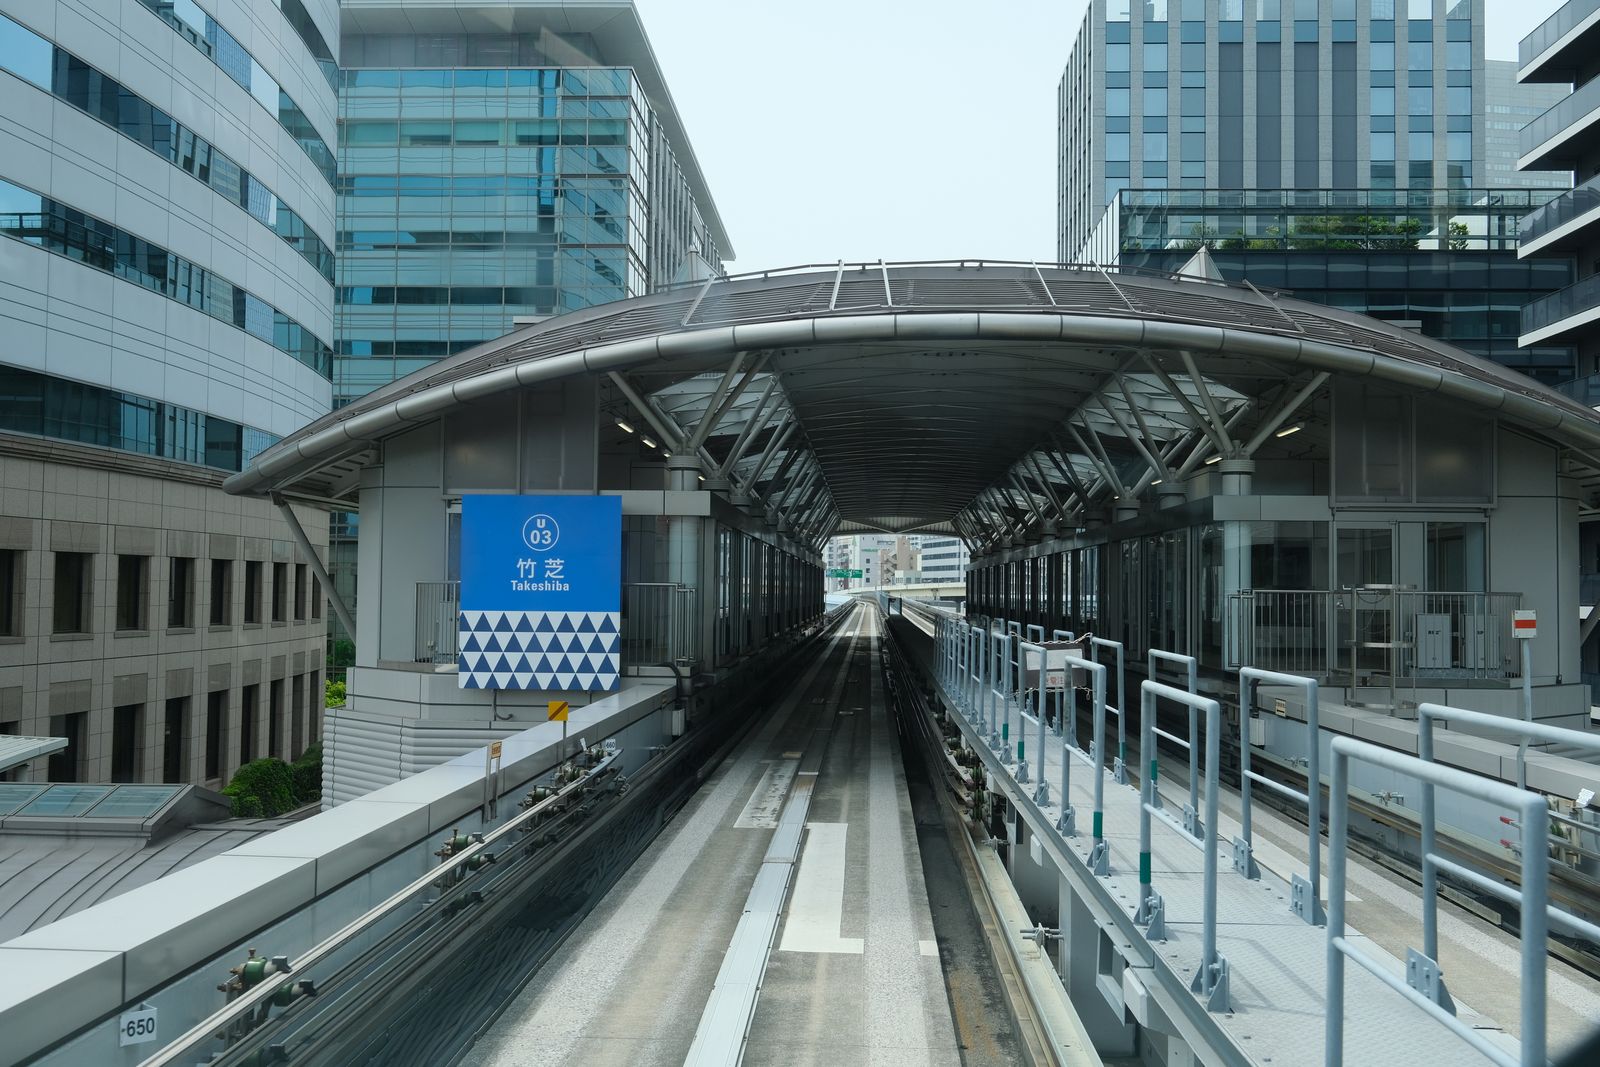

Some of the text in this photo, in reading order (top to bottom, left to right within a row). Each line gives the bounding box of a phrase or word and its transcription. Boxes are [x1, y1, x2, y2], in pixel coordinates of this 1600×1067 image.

[537, 518, 546, 528] U
[530, 530, 552, 544] 03
[516, 558, 565, 578] 竹芝
[510, 580, 570, 591] Takeshiba
